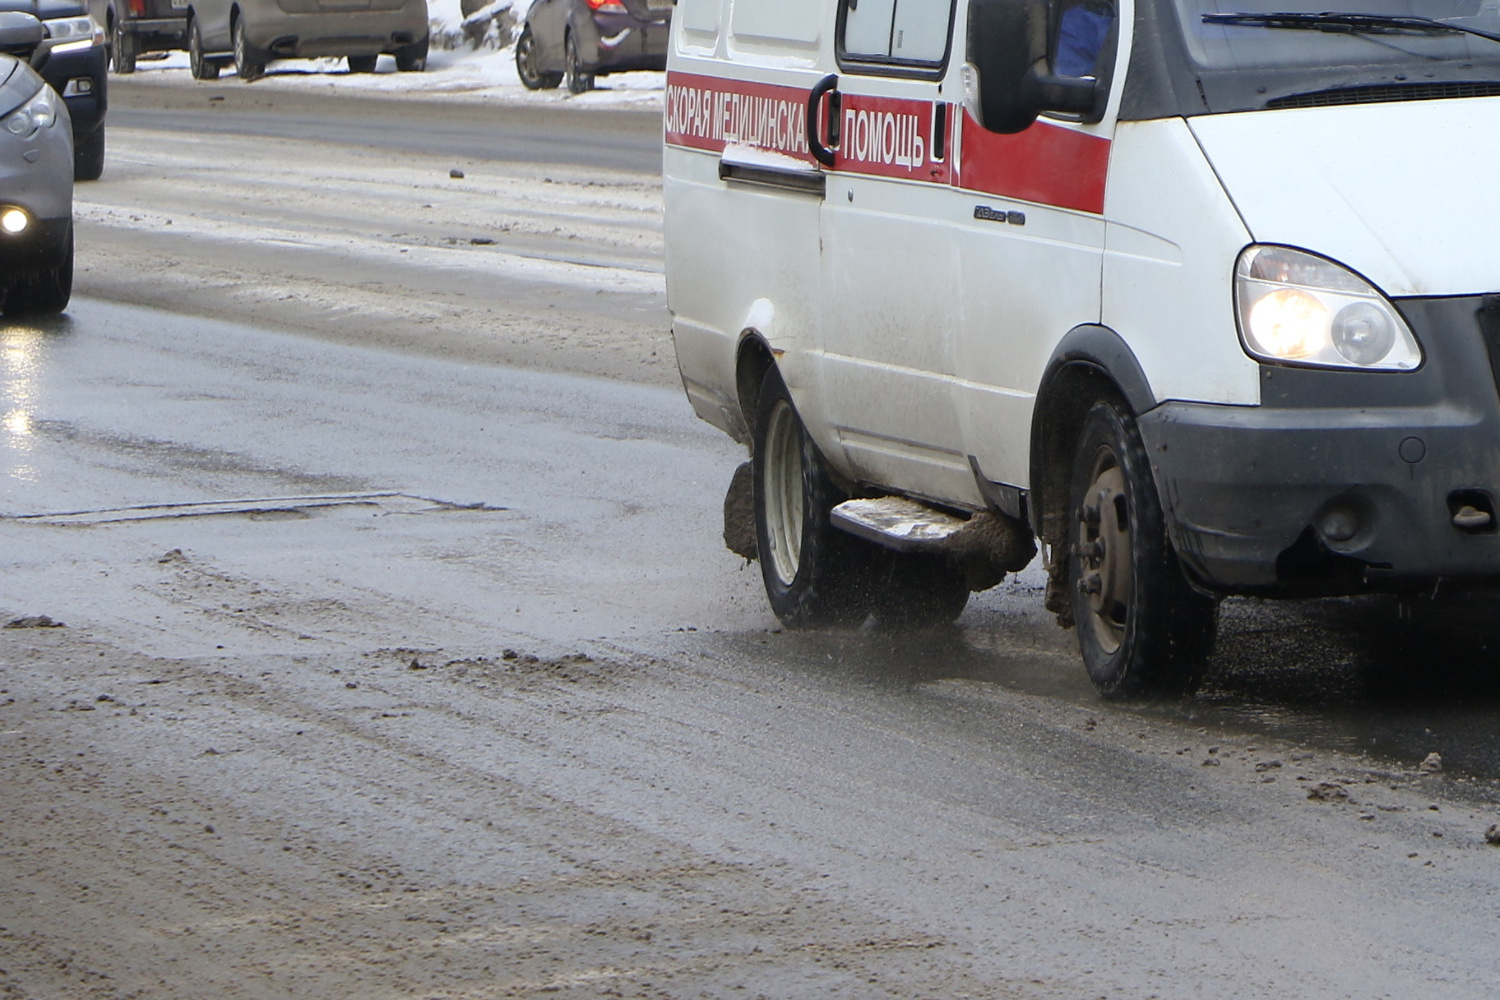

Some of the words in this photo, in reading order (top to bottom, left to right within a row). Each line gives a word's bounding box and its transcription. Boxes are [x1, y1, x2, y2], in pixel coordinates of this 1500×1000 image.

[666, 84, 710, 139] СКОРАЯ
[712, 91, 810, 154] МЕДИЦИНСКА
[844, 108, 924, 171] ПОМОЩЬ
